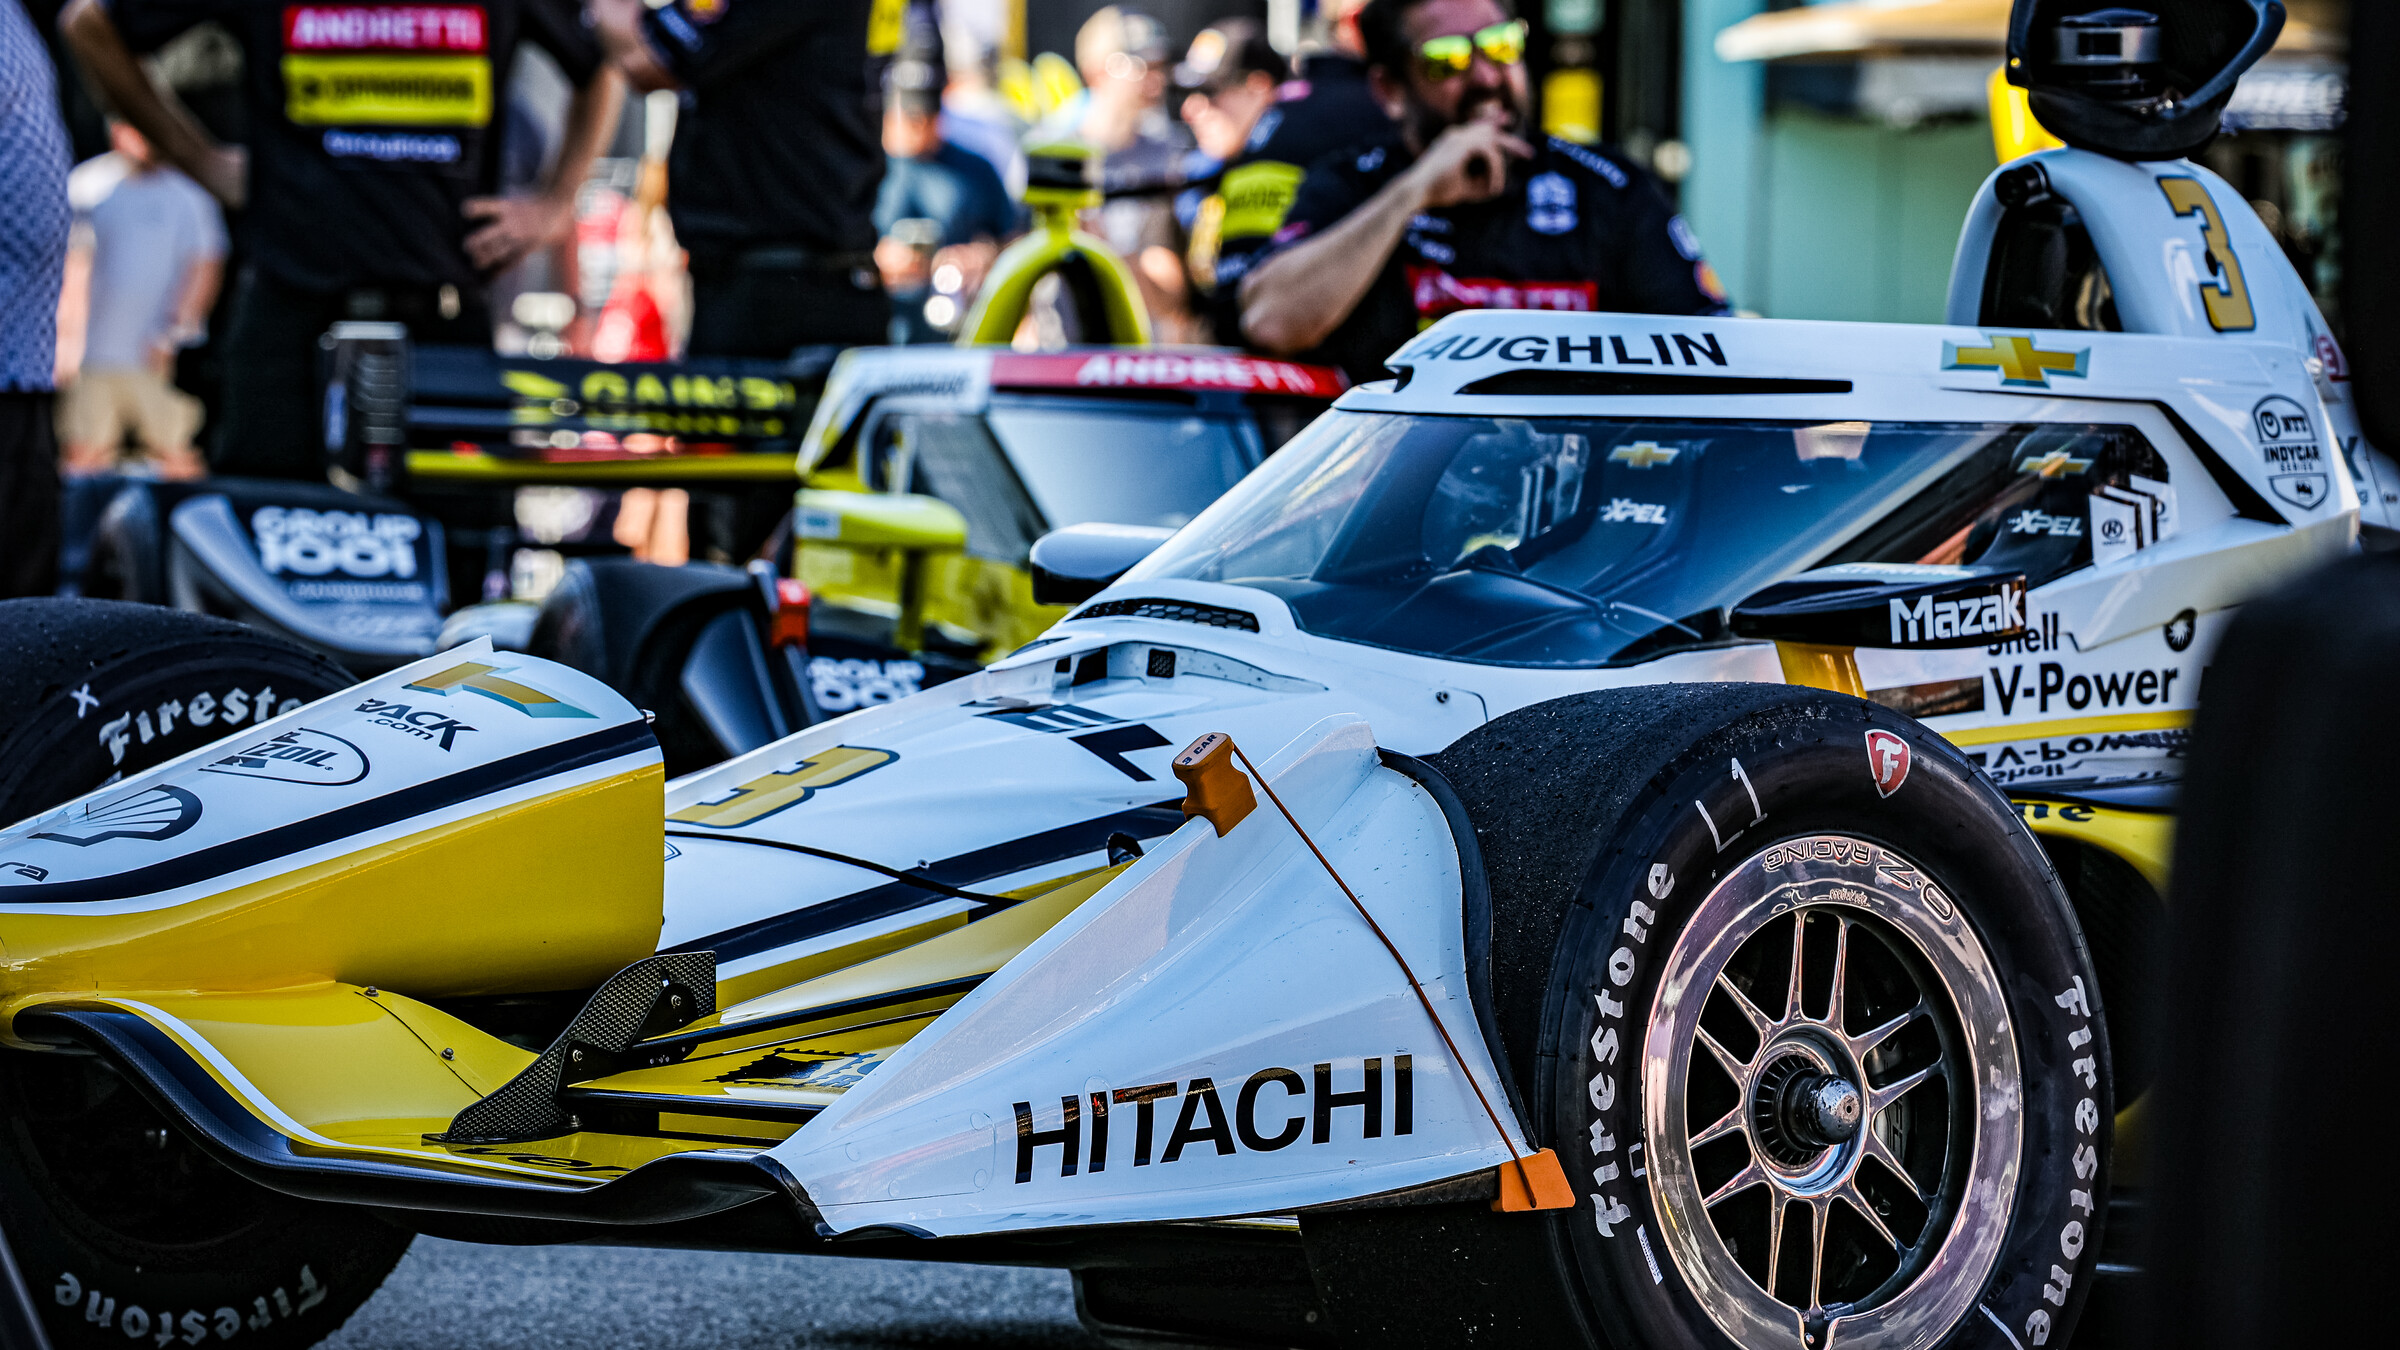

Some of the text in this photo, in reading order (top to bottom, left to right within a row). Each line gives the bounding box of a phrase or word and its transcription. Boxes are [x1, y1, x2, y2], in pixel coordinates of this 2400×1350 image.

[2155, 174, 2257, 333] 3
[1400, 332, 1728, 367] AUGHLIN
[2281, 414, 2308, 432] NTT
[2263, 445, 2321, 463] INDYCAR
[252, 505, 422, 542] GROUP
[1600, 498, 1667, 525] XPEL
[2008, 510, 2082, 536] XPEL
[258, 534, 418, 579] 1001
[1889, 583, 2025, 644] Mazak
[806, 655, 926, 682] ROUP
[1989, 661, 2178, 716] V-Power
[1193, 734, 1217, 755] CAR
[1765, 840, 1871, 869] RACING
[1588, 862, 1676, 1239] Firestone
[1012, 1053, 1415, 1185] HITACHI
[2024, 975, 2098, 1346] Firestone
[54, 1263, 328, 1349] Firestone
